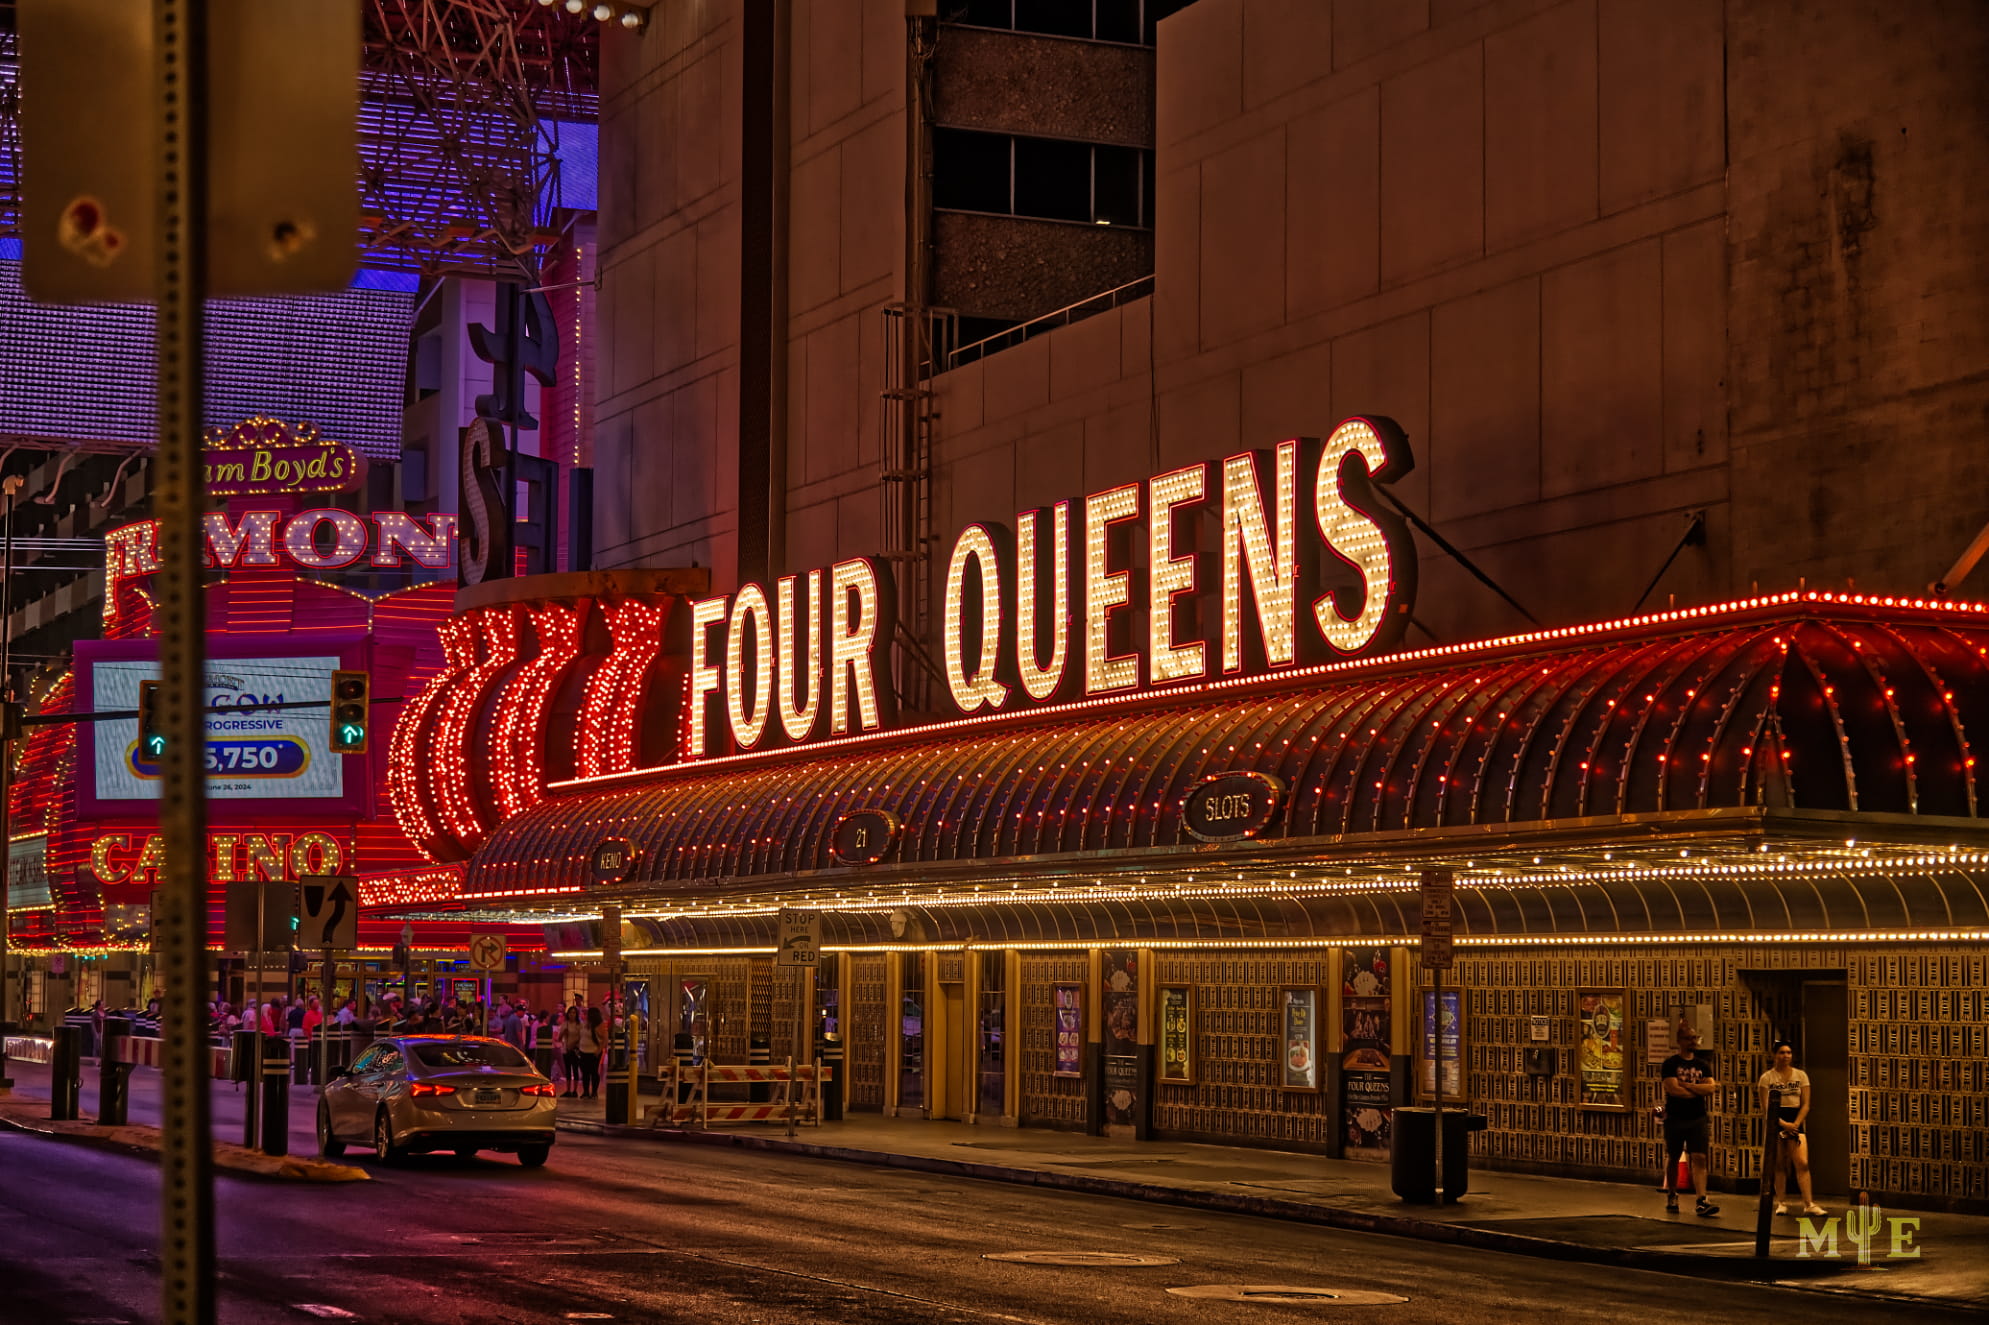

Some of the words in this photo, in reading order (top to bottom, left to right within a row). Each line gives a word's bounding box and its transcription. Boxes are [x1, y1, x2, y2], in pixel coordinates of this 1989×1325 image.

[250, 447, 344, 486] Boyd's
[102, 507, 458, 618] FRMON
[690, 556, 880, 757] FOUR
[944, 415, 1392, 713] QUEENS
[206, 719, 283, 730] ROGRESSIVE
[1205, 793, 1250, 821] SLOTS
[855, 828, 866, 848] 21
[90, 831, 343, 884] CAINO
[600, 851, 621, 870] KENO
[785, 912, 815, 925] STOP
[790, 926, 809, 934] HERE
[792, 951, 815, 962] RED
[1347, 1081, 1364, 1091] FOUR
[1365, 1081, 1389, 1092] QUEENS
